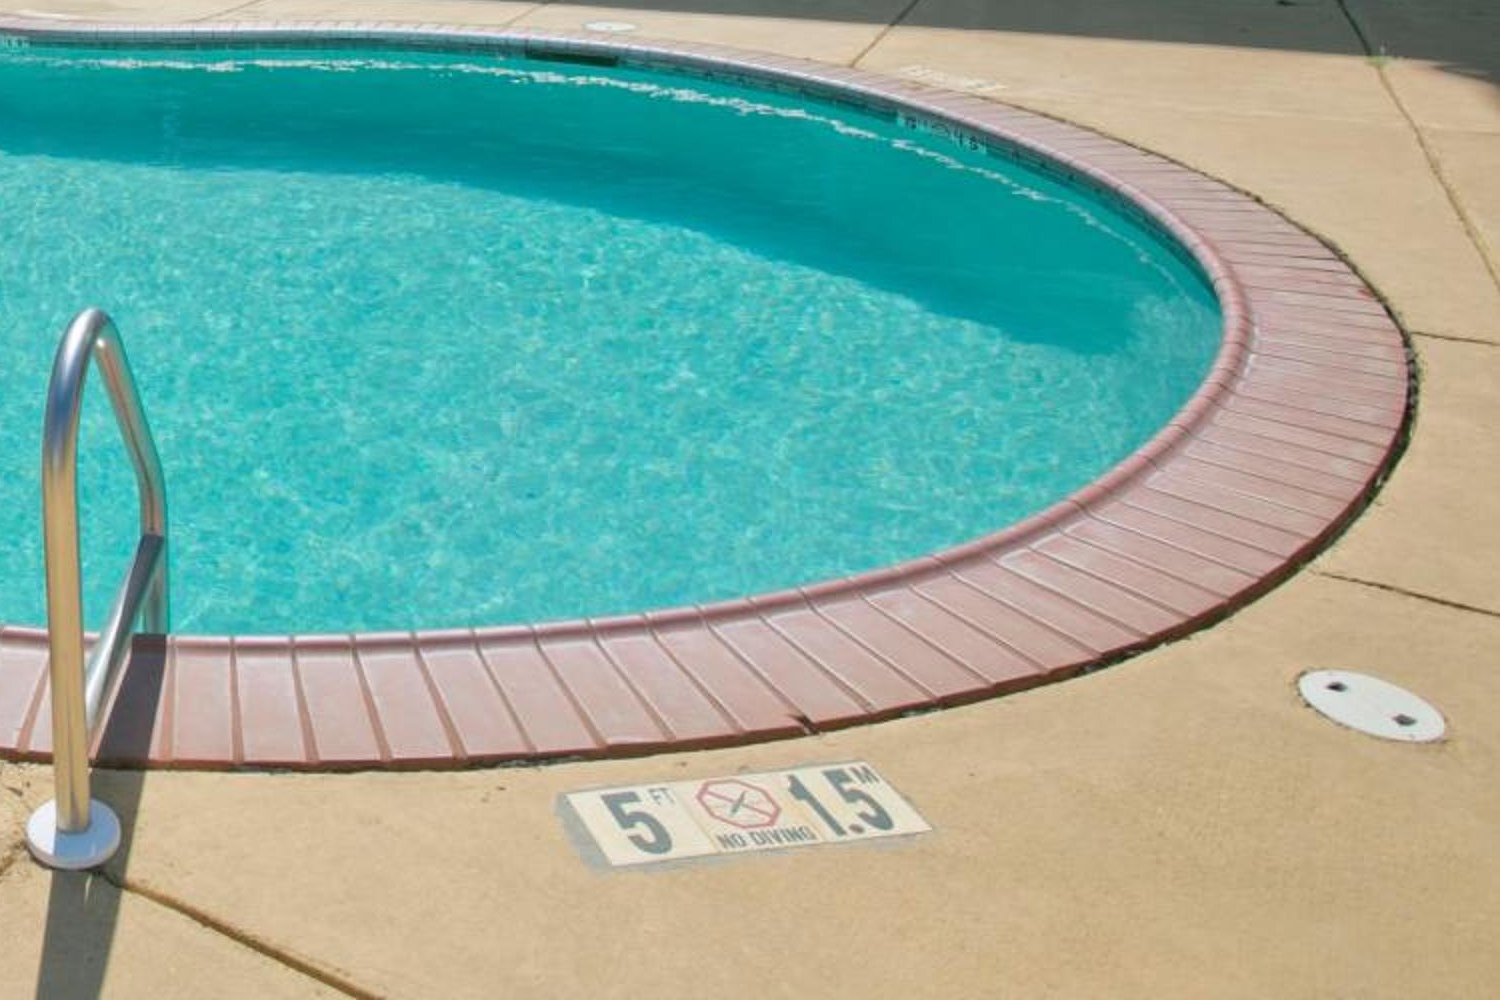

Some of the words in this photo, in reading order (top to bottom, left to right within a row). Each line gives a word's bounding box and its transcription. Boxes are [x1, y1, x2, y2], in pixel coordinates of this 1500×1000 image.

[600, 791, 672, 854] 5
[648, 788, 676, 805] FT
[788, 769, 894, 837] 1.5
[849, 766, 880, 784] M
[716, 832, 747, 849] NO
[749, 826, 817, 845] DIVING
